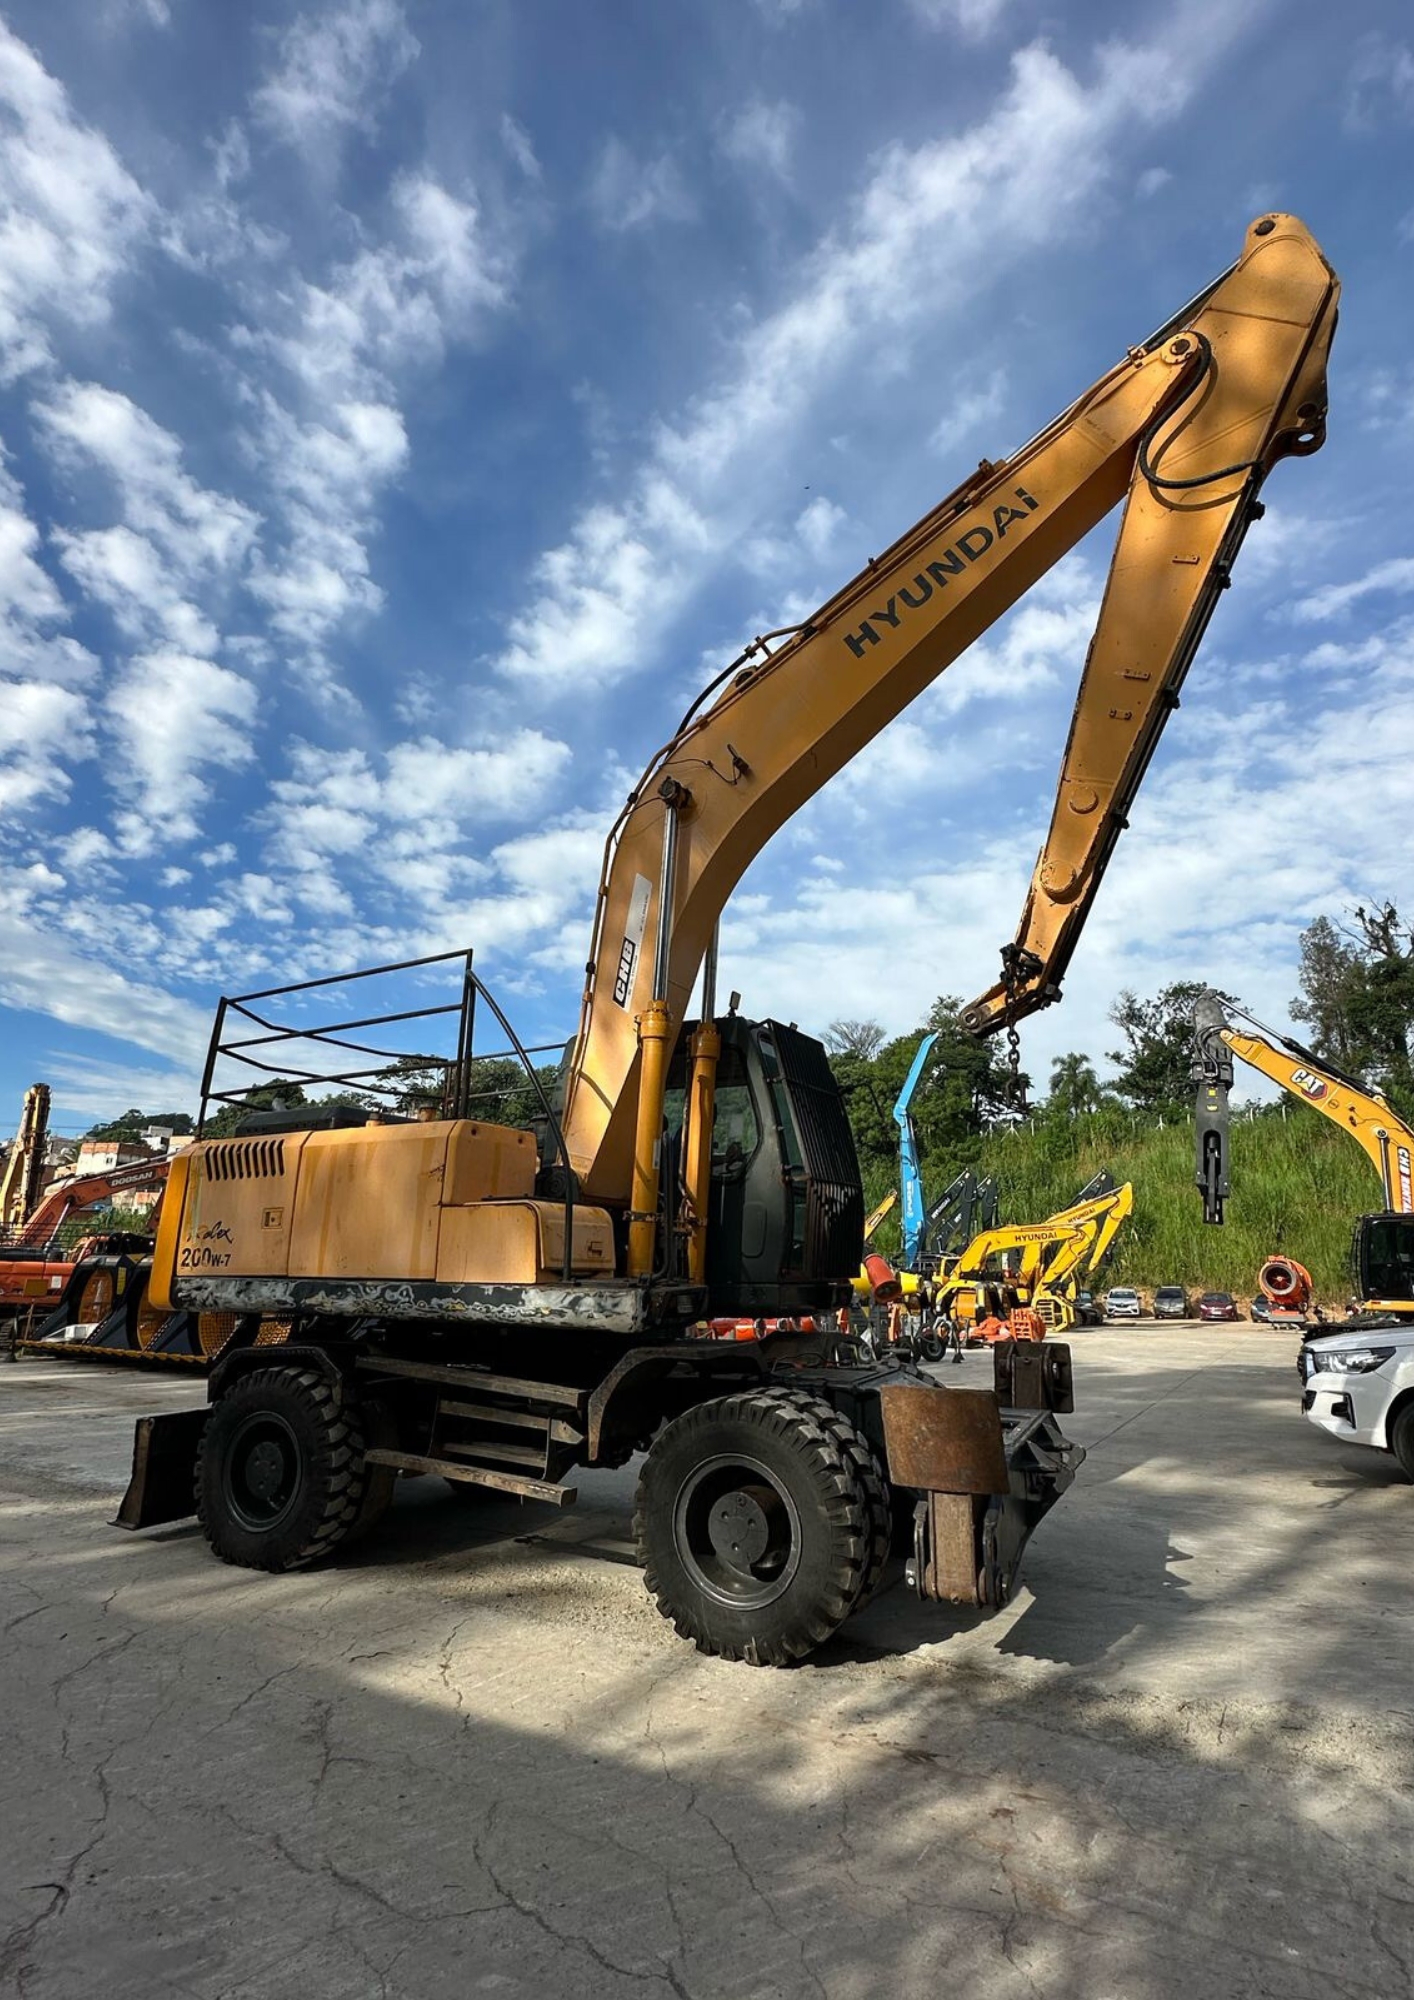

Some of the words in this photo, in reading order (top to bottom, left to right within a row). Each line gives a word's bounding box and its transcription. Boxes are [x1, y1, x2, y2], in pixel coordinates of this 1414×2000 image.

[843, 487, 1040, 659] HYUNDAI
[615, 939, 634, 1003] CHB
[1291, 1068, 1326, 1094] CAT
[111, 1171, 153, 1187] DOOSAN
[1015, 1231, 1057, 1242] HYUNDAI
